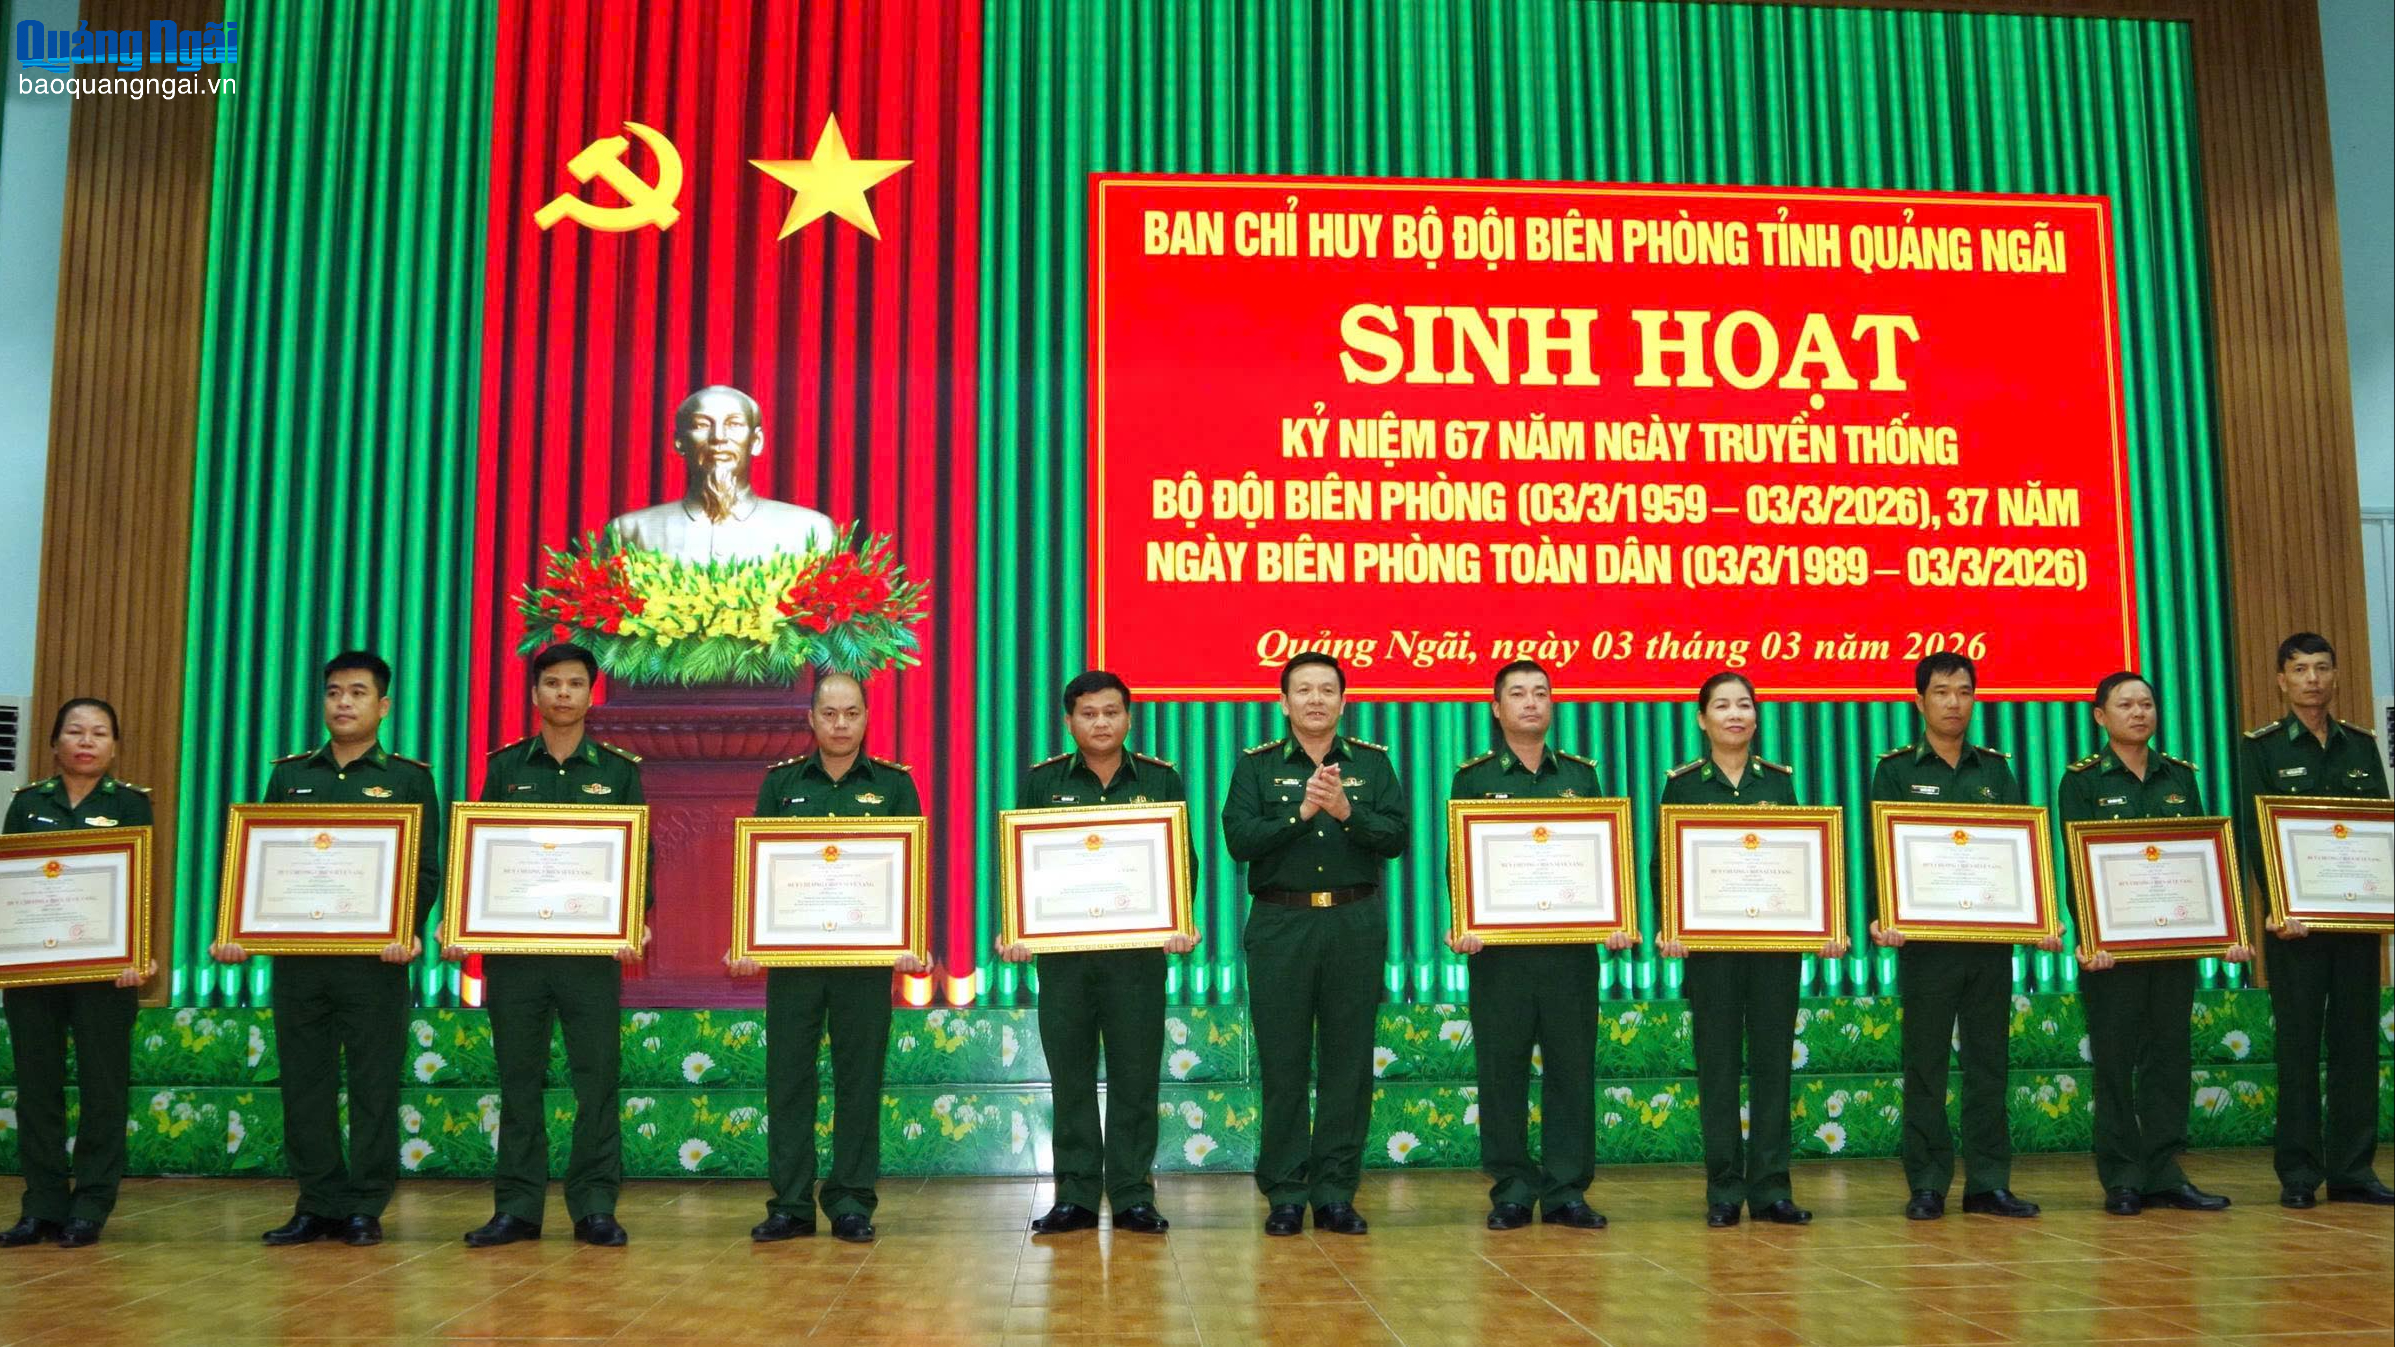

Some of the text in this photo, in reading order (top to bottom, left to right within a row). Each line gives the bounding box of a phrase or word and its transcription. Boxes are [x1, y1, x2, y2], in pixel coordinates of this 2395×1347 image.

[1144, 195, 2067, 274] BAN CHỈ HUY BỘ ĐỘI BIÊN PHÒNG TỈNH QUẢNG NGÃI
[1339, 303, 1921, 411] SINH HOẠT
[1282, 401, 1959, 468] KỶ NIỆM 67 NĂM NGÀY TRUYỀN THỐNG
[1152, 470, 1204, 529] BỘ
[1211, 470, 1275, 529] ĐỘI
[1284, 471, 1373, 521] BIÊN
[1380, 471, 1507, 522] PHÒNG
[1518, 482, 1708, 527] (03/3/1959
[1746, 484, 1942, 531] 03/3/2026),
[1946, 487, 1989, 527] 37
[1997, 480, 2080, 527] NĂM
[1146, 532, 1248, 583] NGÀY
[1257, 533, 1345, 583] BIÊN
[1353, 532, 1481, 584] PHÒNG
[1489, 535, 1588, 585] TOÀN
[1595, 535, 1672, 585] DÂN
[1682, 543, 1869, 590] (03/3/1989
[1907, 546, 2088, 591] 03/3/2026)
[1256, 629, 1378, 668] Quảng
[1385, 630, 1477, 668] Ngãi,
[1490, 636, 1580, 668] ngày
[1592, 631, 1634, 660] 03
[1645, 630, 1751, 668] tháng
[1761, 631, 1802, 660] 03
[1813, 633, 1890, 661] năm
